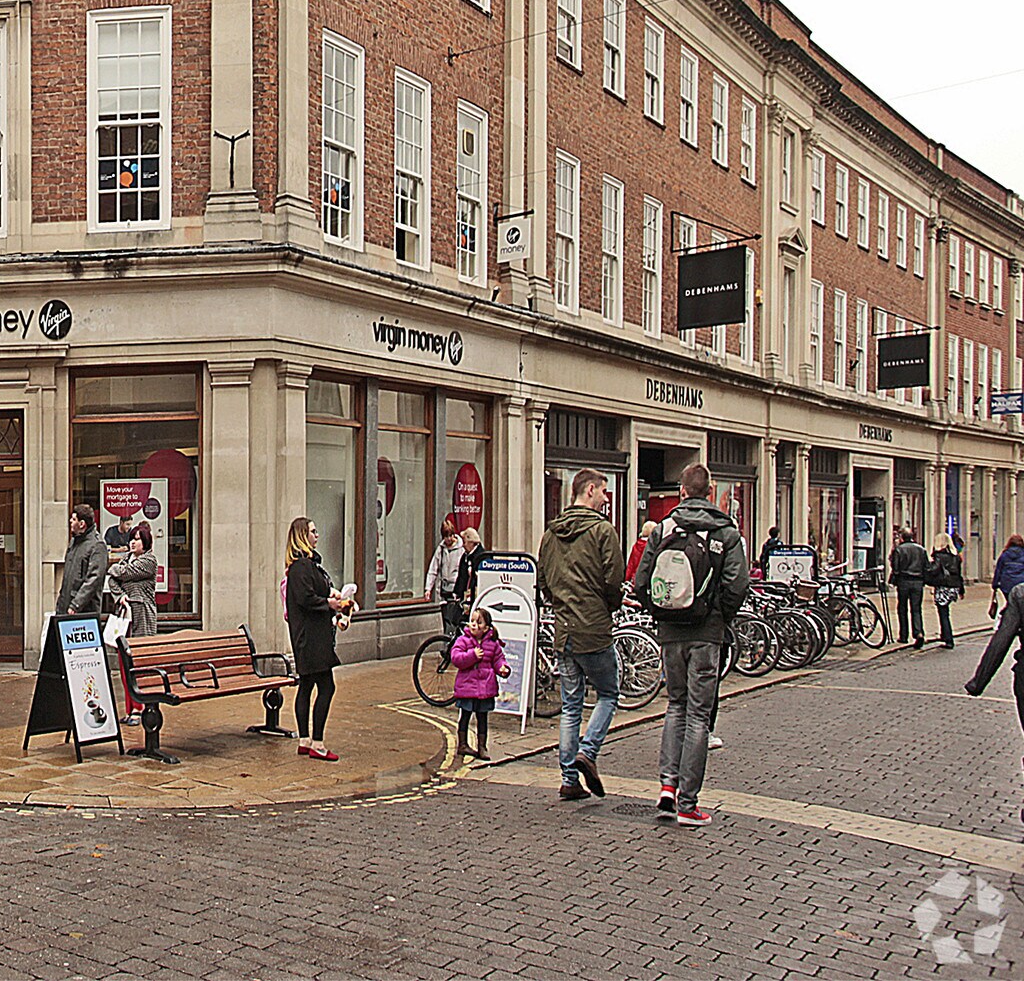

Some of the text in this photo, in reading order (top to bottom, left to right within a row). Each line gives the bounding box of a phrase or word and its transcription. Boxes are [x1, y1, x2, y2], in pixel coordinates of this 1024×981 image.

[500, 244, 526, 254] money
[685, 282, 739, 297] DEBENHAMS
[40, 303, 71, 336] Virgin
[372, 316, 406, 353] virgin
[408, 328, 448, 361] money
[883, 358, 924, 367] DEBENHAMS
[646, 378, 704, 410] DEBENHAMS
[991, 400, 1022, 408] HALIFAX
[859, 423, 893, 443] DEBENHAMS
[454, 504, 481, 515] banking better
[482, 560, 529, 571] Davygate (South)
[66, 631, 95, 645] NERO
